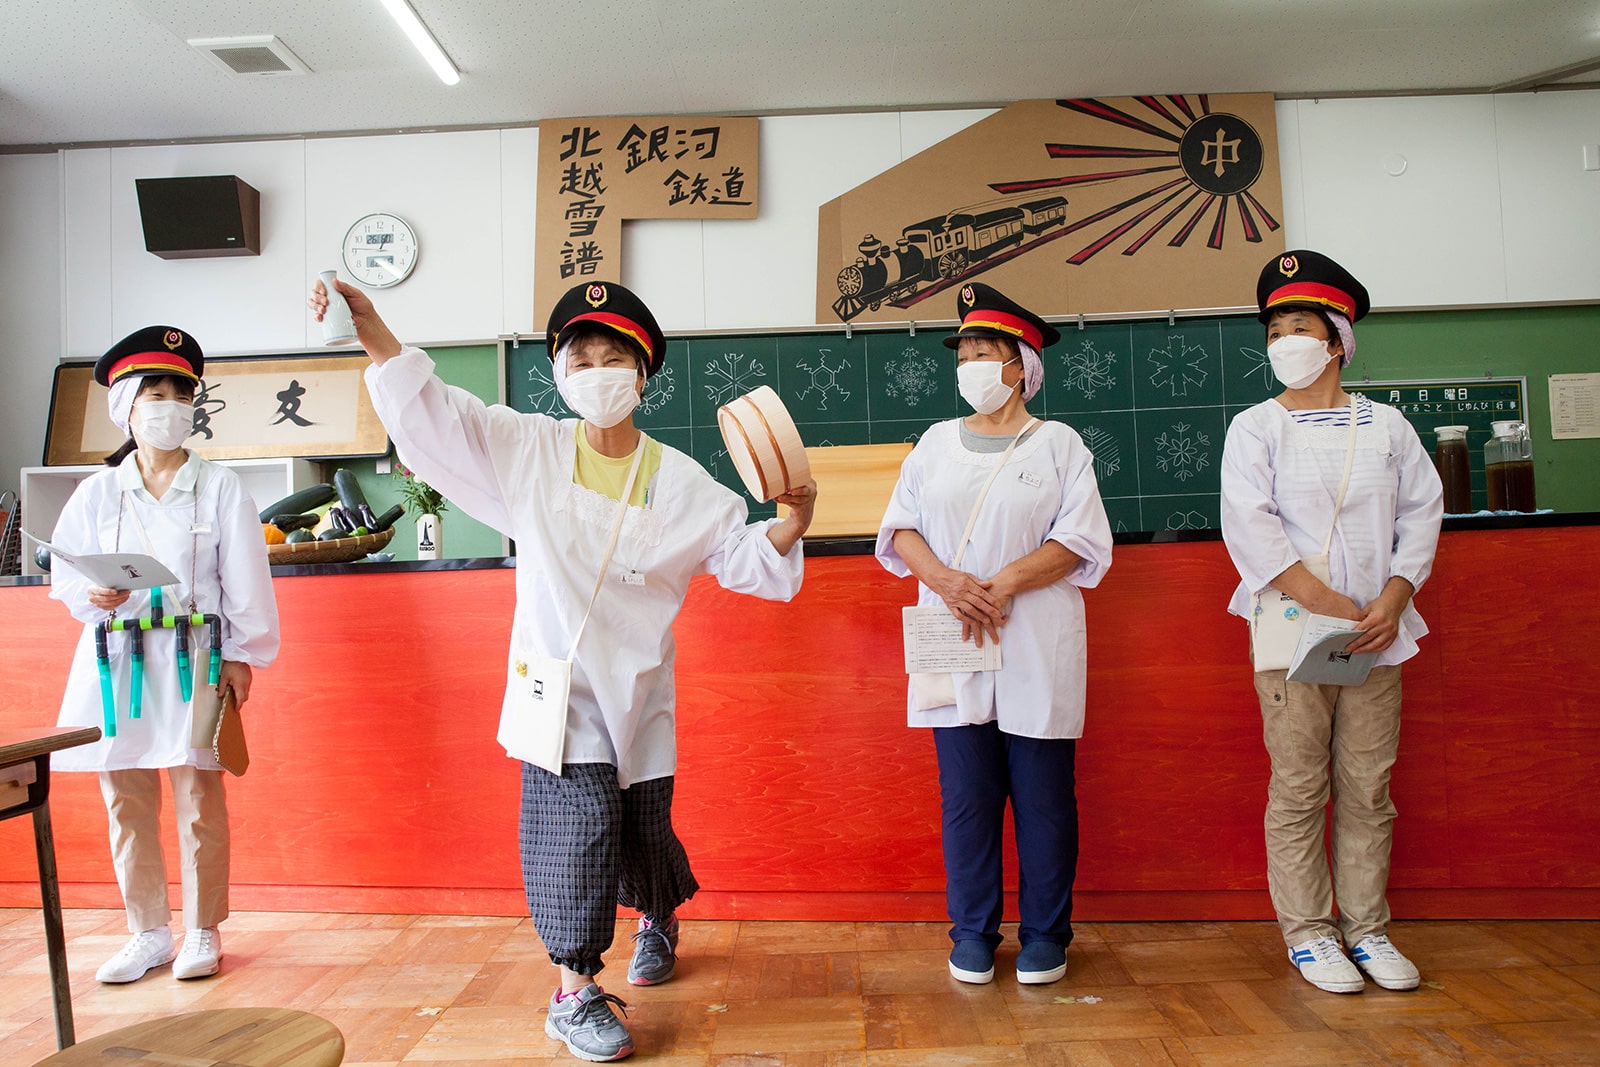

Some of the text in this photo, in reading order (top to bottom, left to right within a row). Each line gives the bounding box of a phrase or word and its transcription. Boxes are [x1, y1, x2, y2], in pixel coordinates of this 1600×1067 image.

[616, 123, 721, 174] 銀河
[559, 126, 608, 279] 北越雪譜
[364, 225, 370, 233] 11
[376, 221, 384, 229] 12
[1389, 388, 1468, 402] 月 日 曜日
[1390, 401, 1516, 413] すること じゅんび 行事
